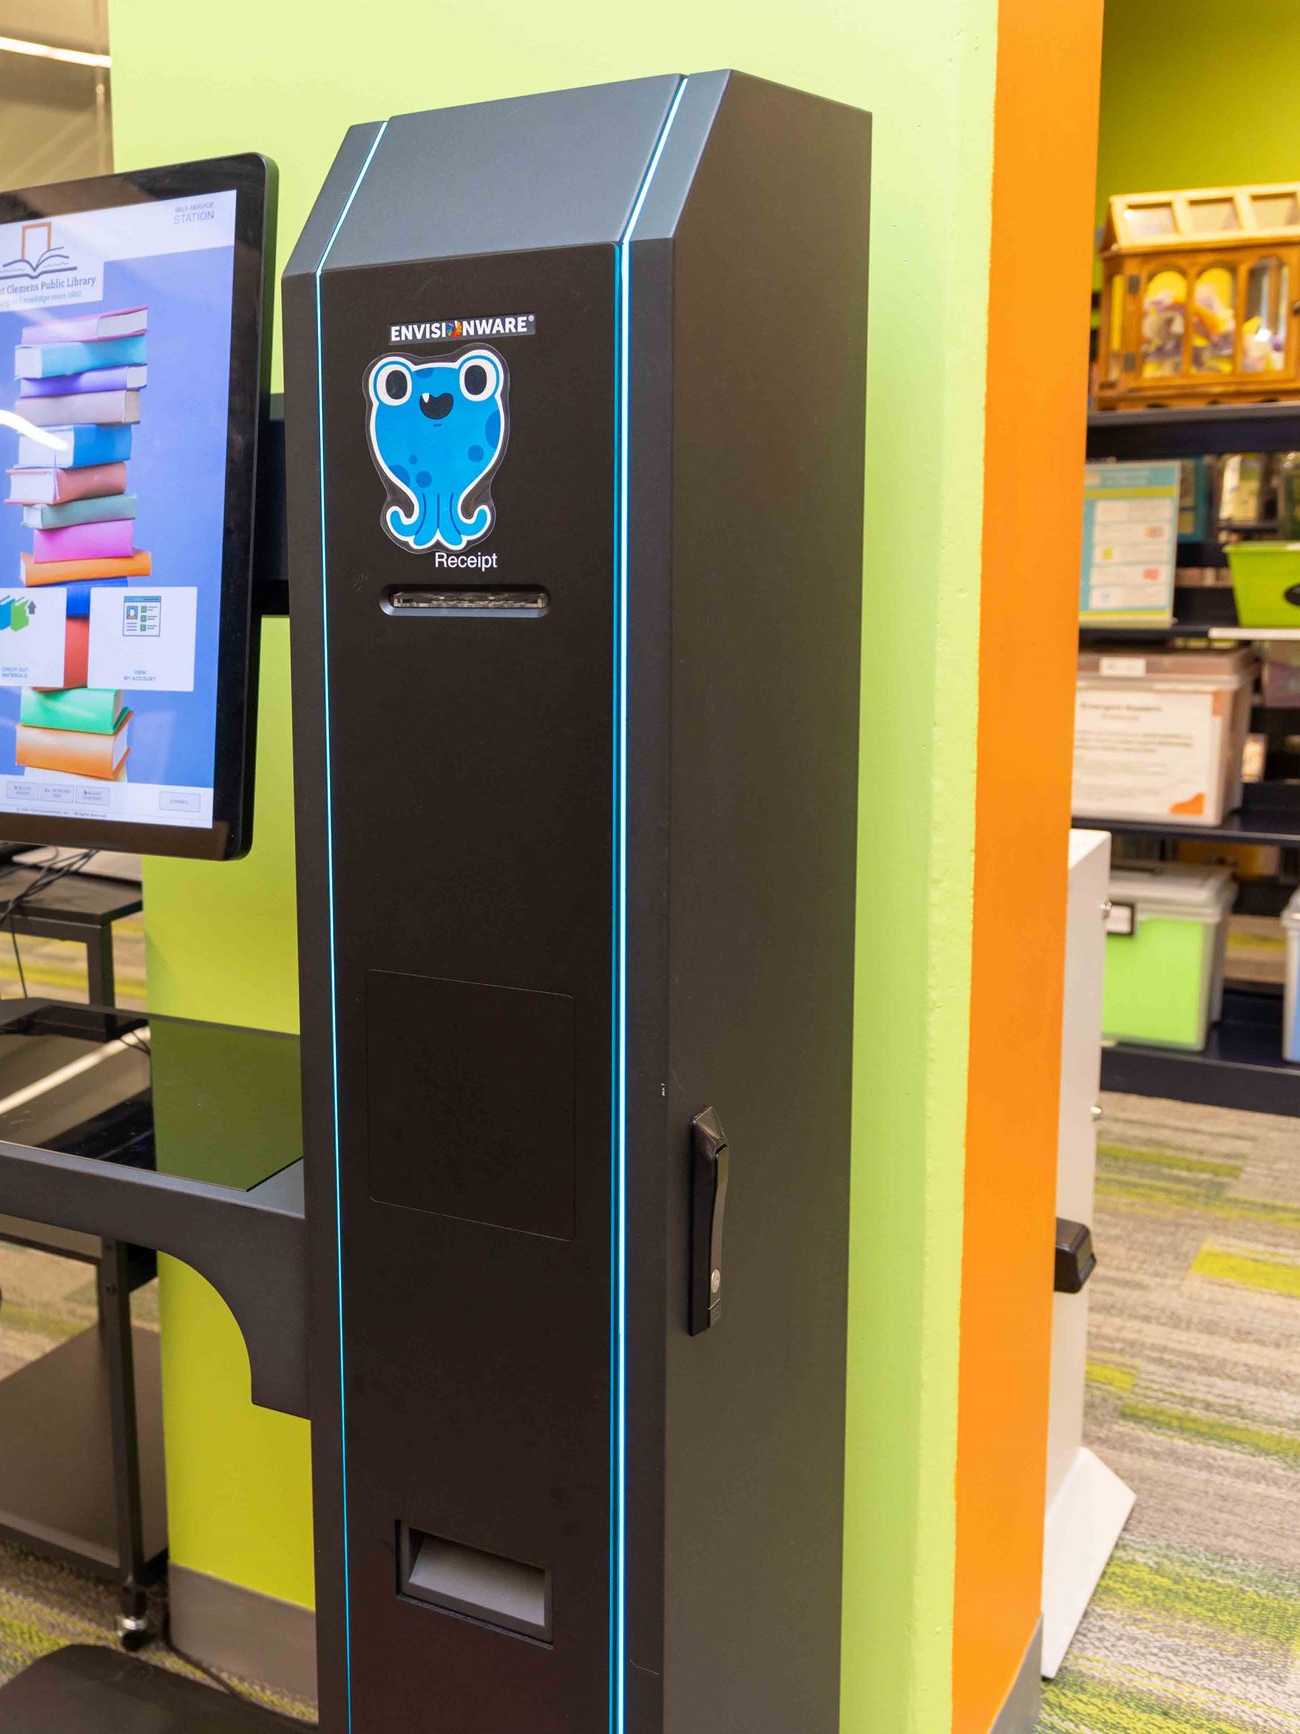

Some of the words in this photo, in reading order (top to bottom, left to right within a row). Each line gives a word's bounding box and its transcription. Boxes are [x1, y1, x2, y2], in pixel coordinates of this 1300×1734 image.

[173, 210, 215, 225] STATION
[6, 282, 39, 295] Clemens
[40, 279, 66, 291] Public
[66, 275, 97, 289] Library
[434, 552, 498, 572] Receipt
